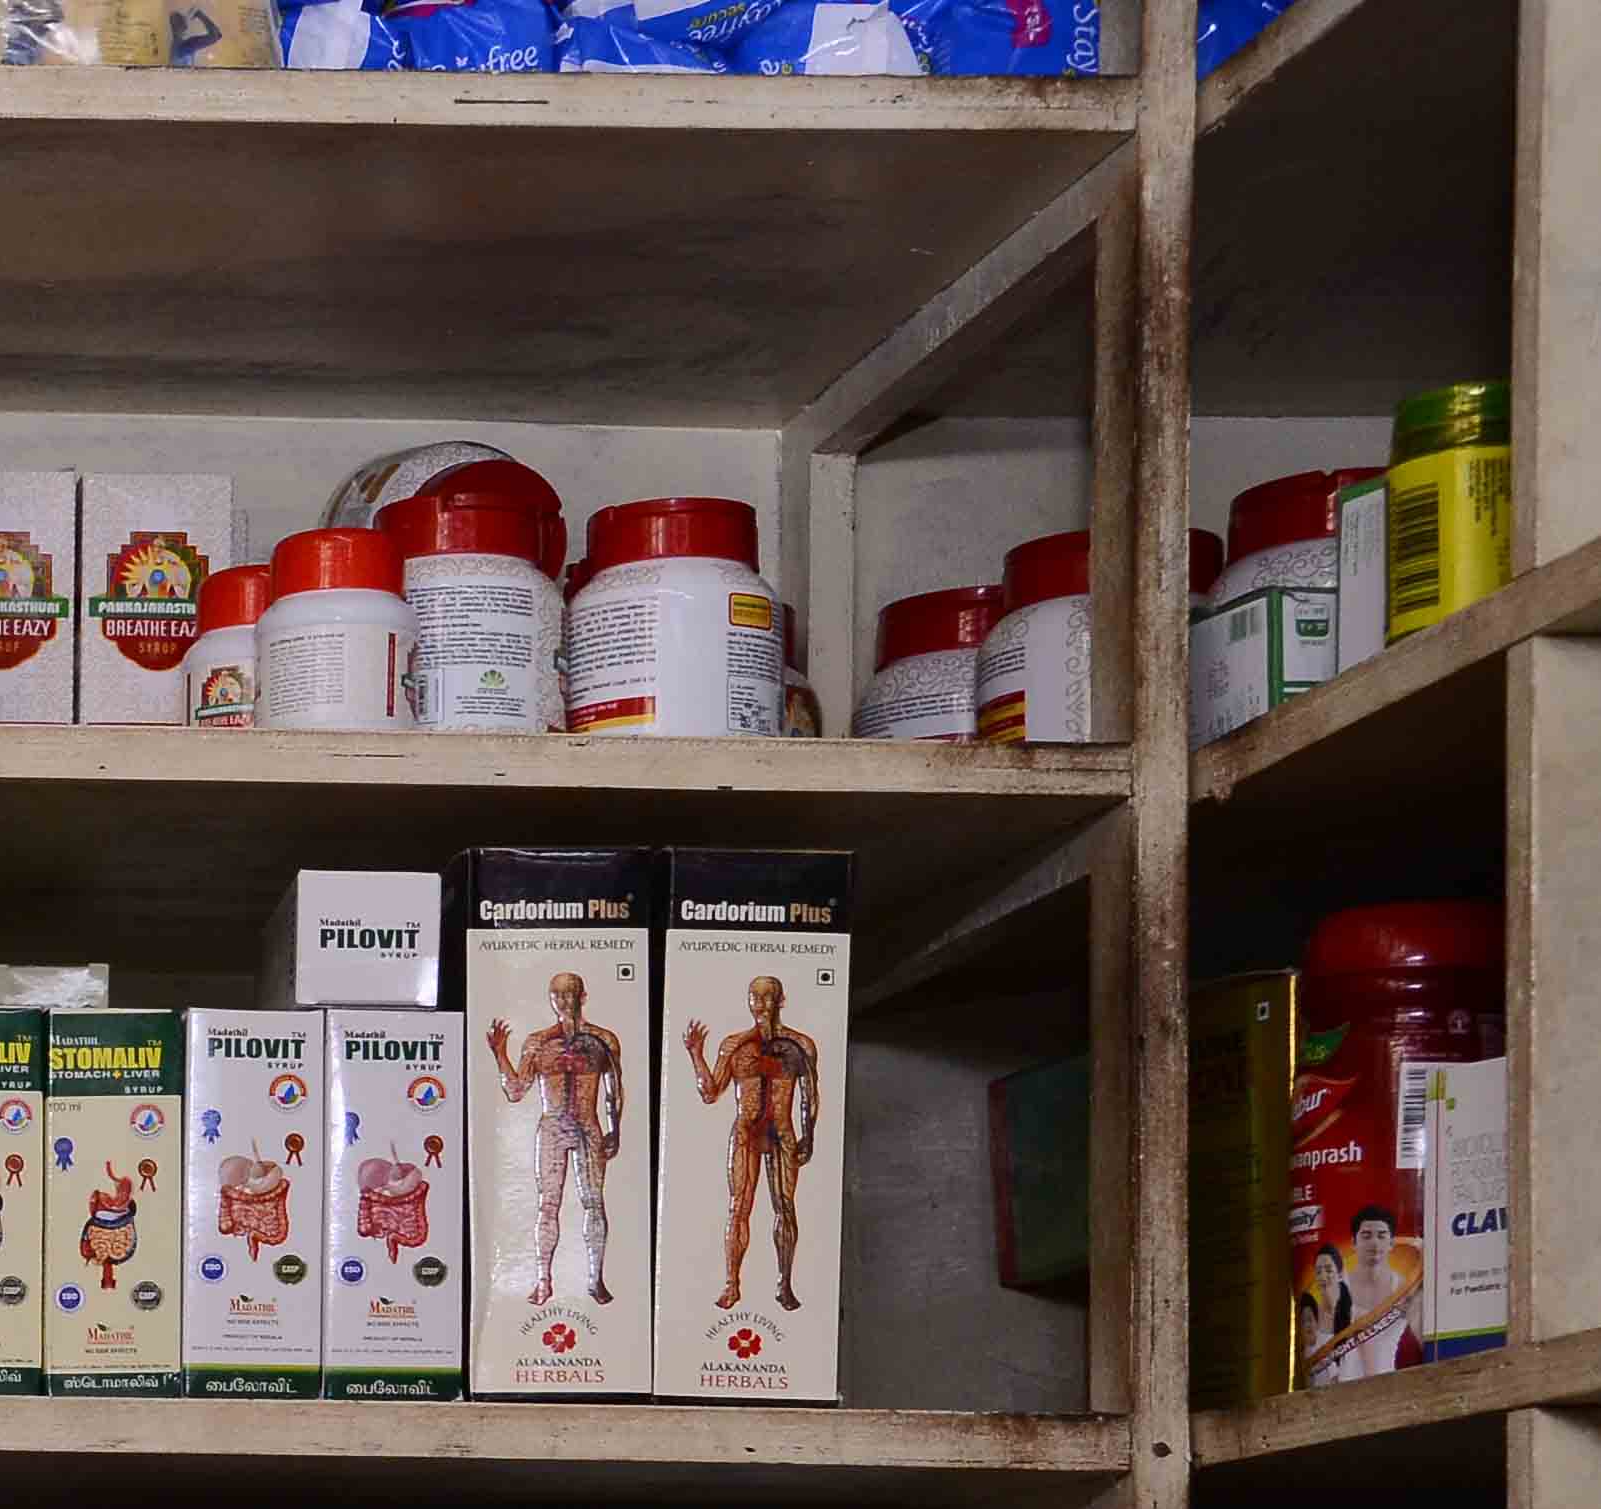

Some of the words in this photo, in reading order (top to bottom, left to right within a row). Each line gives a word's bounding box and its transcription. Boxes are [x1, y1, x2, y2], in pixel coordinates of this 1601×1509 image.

[14, 618, 52, 638] EAZY
[106, 618, 168, 638] BREATHE
[480, 898, 584, 921] Cardorium
[588, 897, 630, 920] Plus
[681, 900, 785, 923] Cardorium
[790, 903, 832, 925] Plus
[319, 928, 420, 950] PILOVIT
[479, 939, 541, 951] AYURVEDIC
[544, 940, 588, 950] HERBAL
[589, 940, 636, 950] REMEDY
[679, 941, 742, 953] AYURVEDIC
[745, 942, 788, 954] HERBAL
[790, 943, 837, 955] REMEDY
[50, 1047, 162, 1069] STOMALIV
[207, 1038, 306, 1060] PILOVIT
[344, 1039, 443, 1062] PILOVIT
[50, 1070, 111, 1079] STOMACH
[123, 1070, 161, 1079] LIVER
[520, 1307, 564, 1336] HEALTHY
[566, 1309, 599, 1337] LIVING
[516, 1357, 602, 1368] ALAKANANDA
[701, 1362, 786, 1373] ALAKANANDA
[515, 1369, 605, 1384] HERBALS
[699, 1375, 788, 1390] HERBALS
